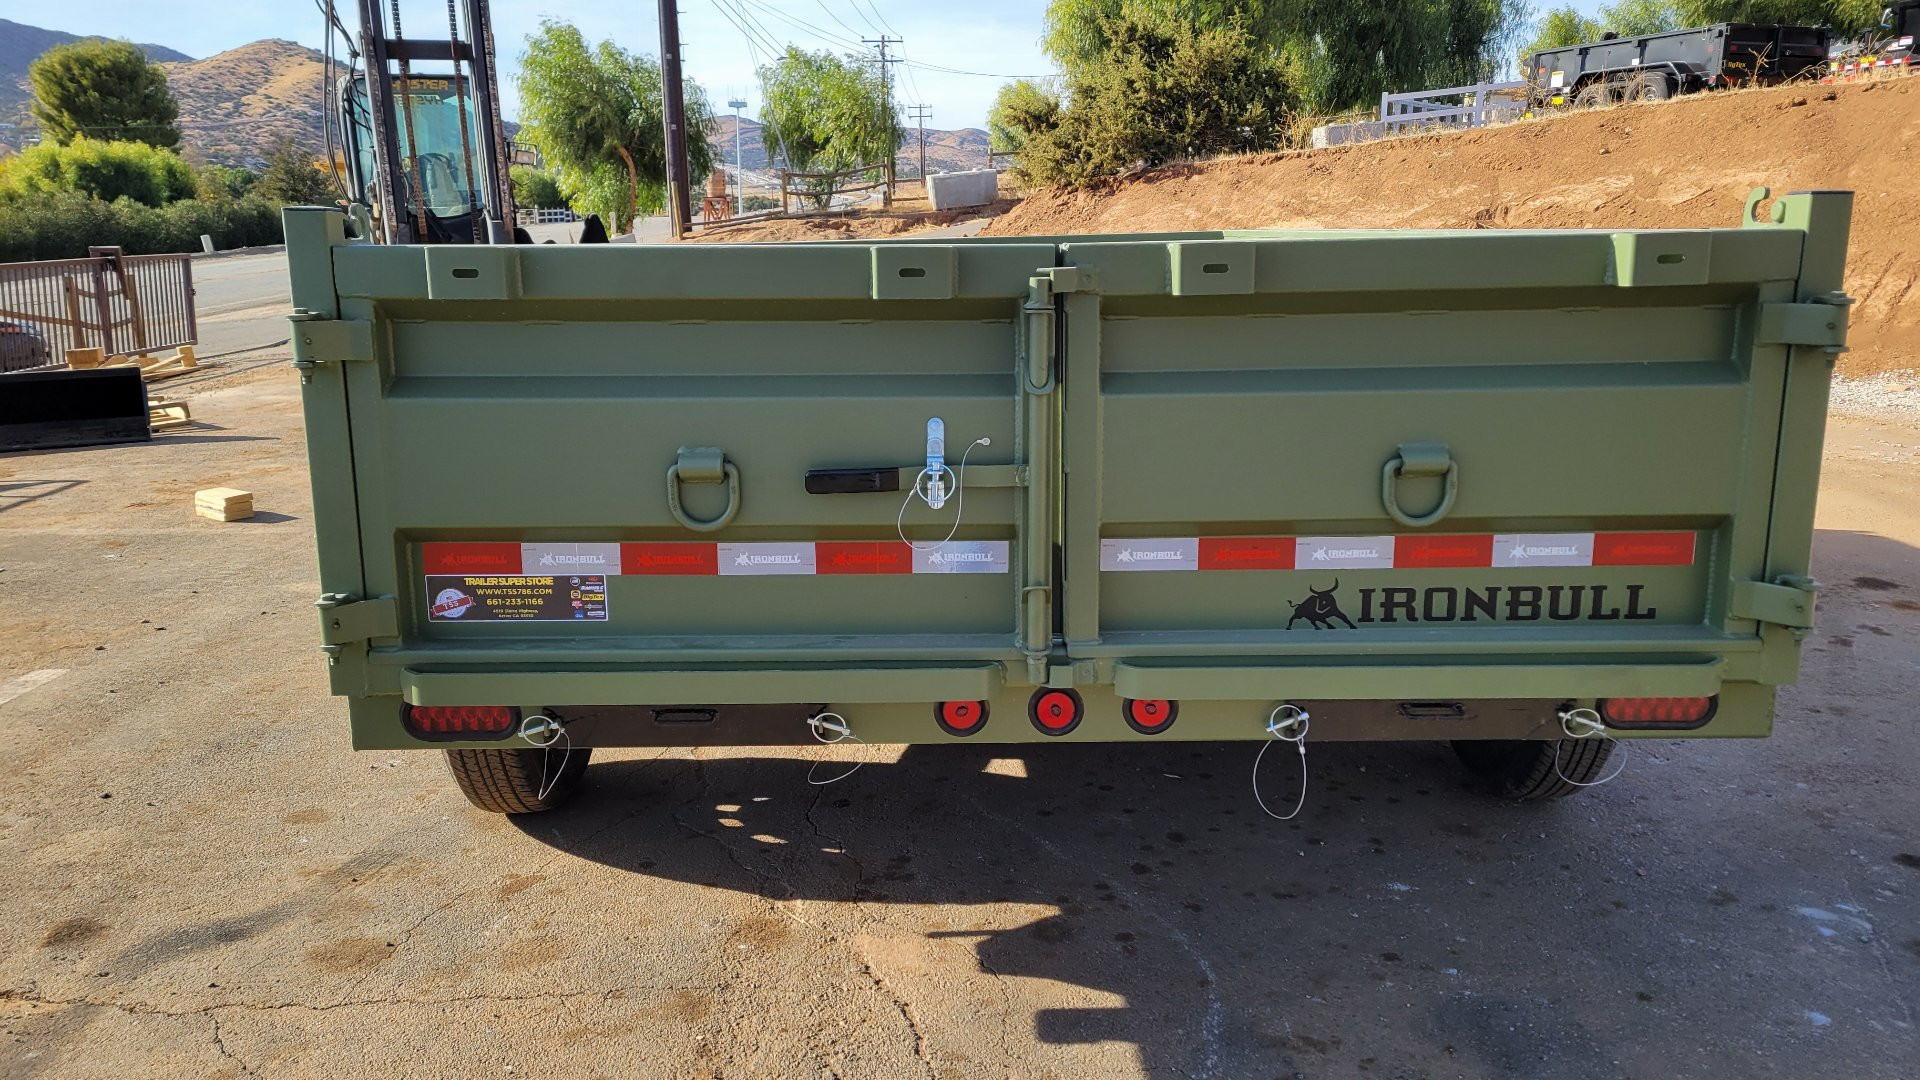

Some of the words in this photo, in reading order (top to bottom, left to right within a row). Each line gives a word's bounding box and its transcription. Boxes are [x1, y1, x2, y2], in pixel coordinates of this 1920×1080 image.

[391, 79, 449, 90] HSTER
[1132, 549, 1183, 560] IRONBULL
[1328, 548, 1378, 558] IRONBULL
[1526, 545, 1578, 556] IRONBULL
[555, 554, 606, 564] IRONBULL
[750, 553, 800, 564] IRONBULL
[944, 551, 993, 562] IRONBULL
[464, 577, 498, 586] TRAILER
[499, 577, 526, 585] SUPER
[527, 576, 554, 585] STORE
[442, 600, 459, 610] TSS
[486, 598, 544, 606] 661-233-1166
[1358, 585, 1656, 623] IRONBULL
